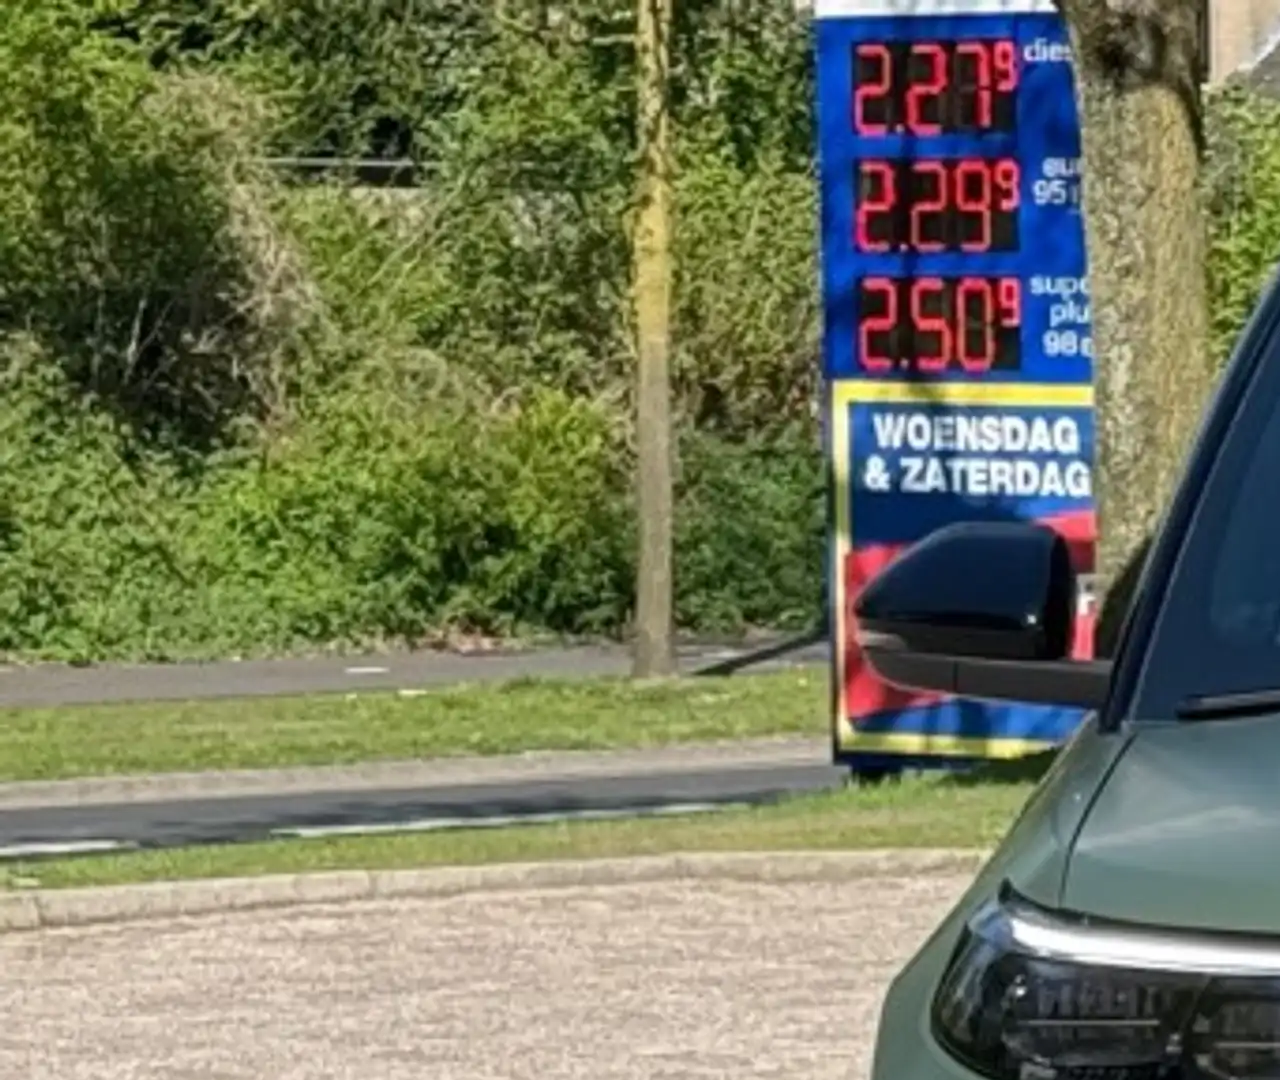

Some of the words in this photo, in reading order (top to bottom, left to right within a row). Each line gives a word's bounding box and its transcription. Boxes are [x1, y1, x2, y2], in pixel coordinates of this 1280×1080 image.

[1033, 180, 1067, 206] 95
[1043, 329, 1079, 356] 98
[872, 414, 1079, 452] WOENSDAG
[863, 457, 890, 492] &
[899, 457, 1091, 497] ZATERDAG
